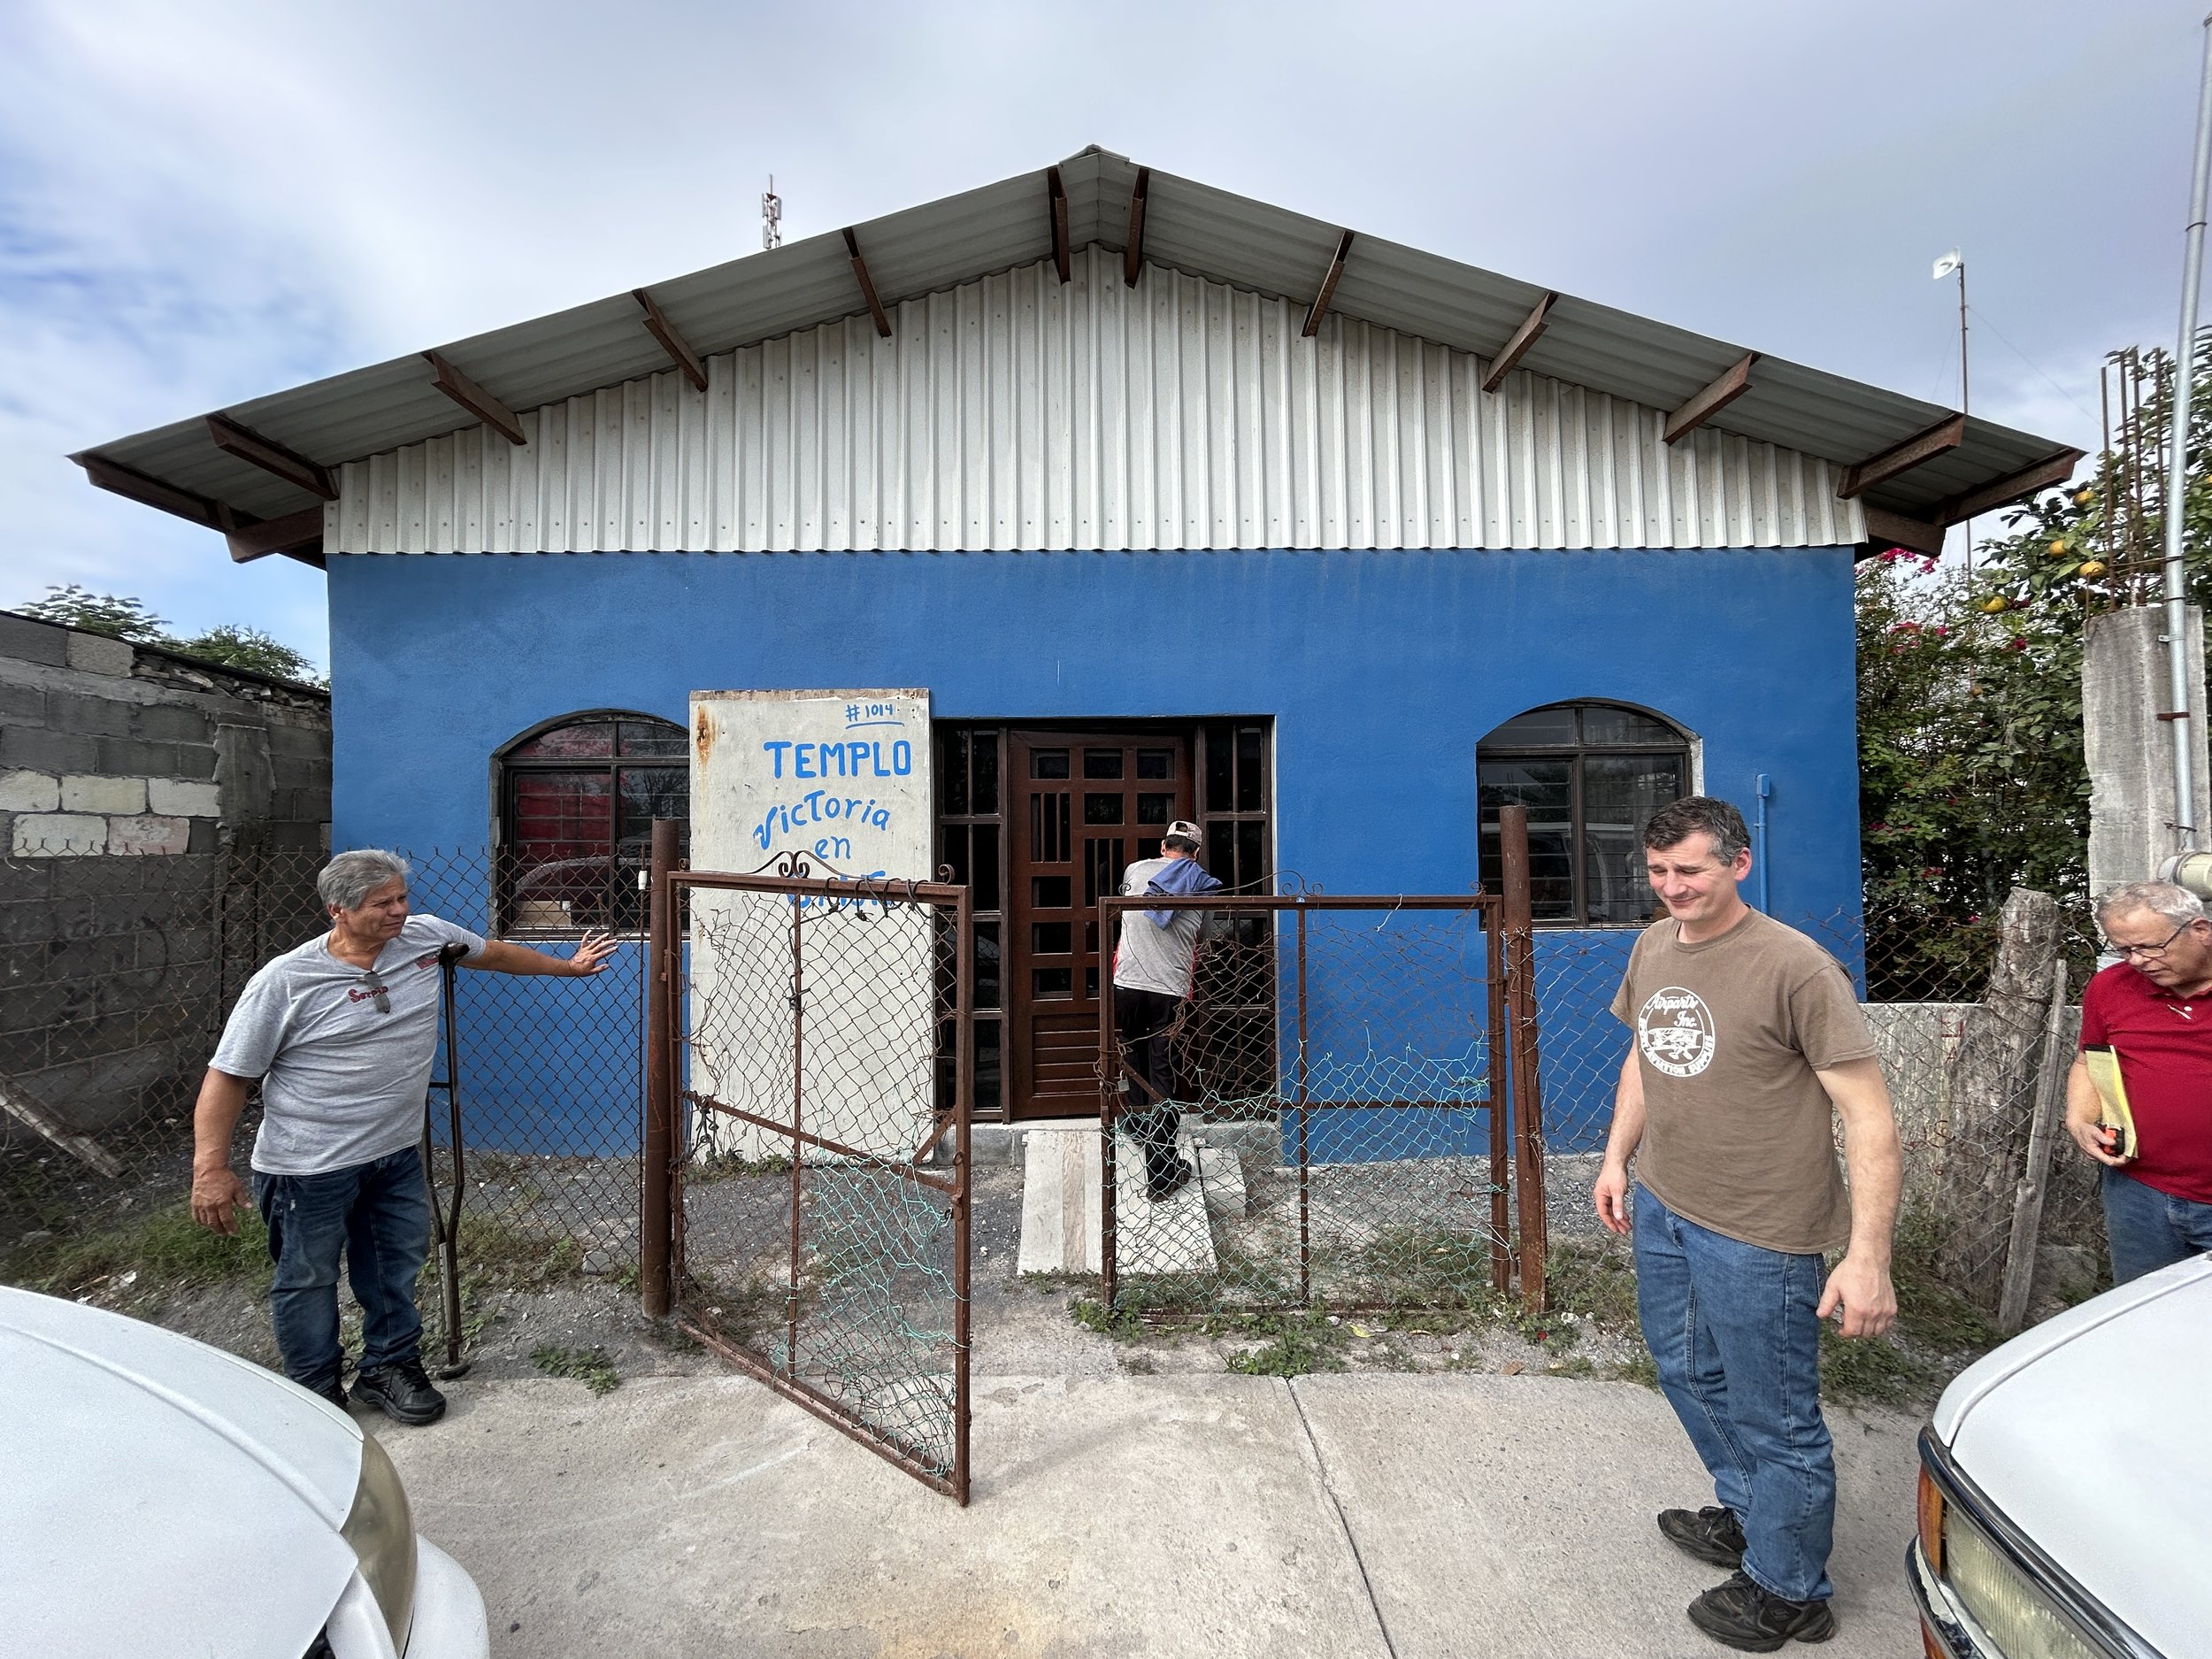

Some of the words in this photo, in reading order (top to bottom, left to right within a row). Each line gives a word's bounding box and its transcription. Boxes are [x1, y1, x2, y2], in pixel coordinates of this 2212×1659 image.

[764, 741, 910, 779] TEMPLO
[815, 836, 850, 859] en
[1674, 1010, 1697, 1027] Inc.
